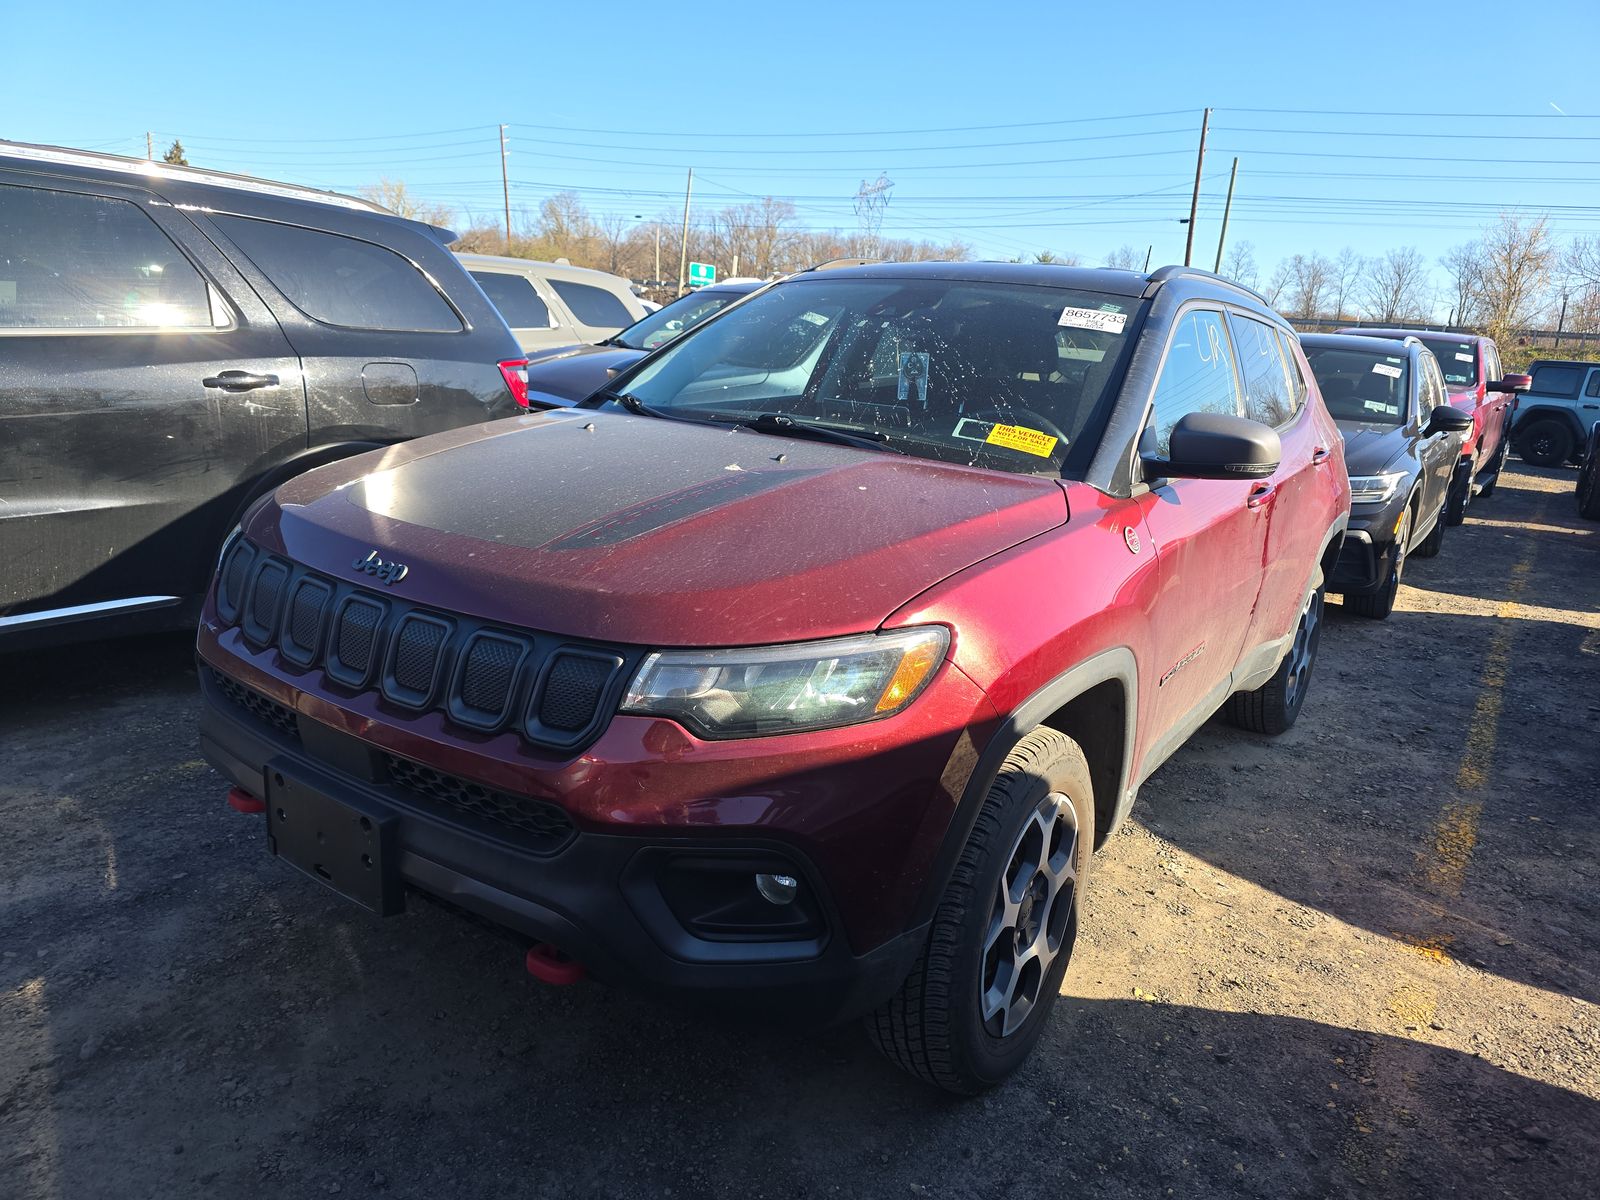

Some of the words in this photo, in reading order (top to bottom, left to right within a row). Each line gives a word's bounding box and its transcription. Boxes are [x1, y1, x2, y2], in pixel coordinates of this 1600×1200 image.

[1065, 309, 1126, 324] 8657733
[998, 426, 1016, 434] THIS
[1018, 430, 1053, 443] VEHICLE
[1013, 434, 1028, 442] FOR
[352, 550, 408, 585] Jeep
